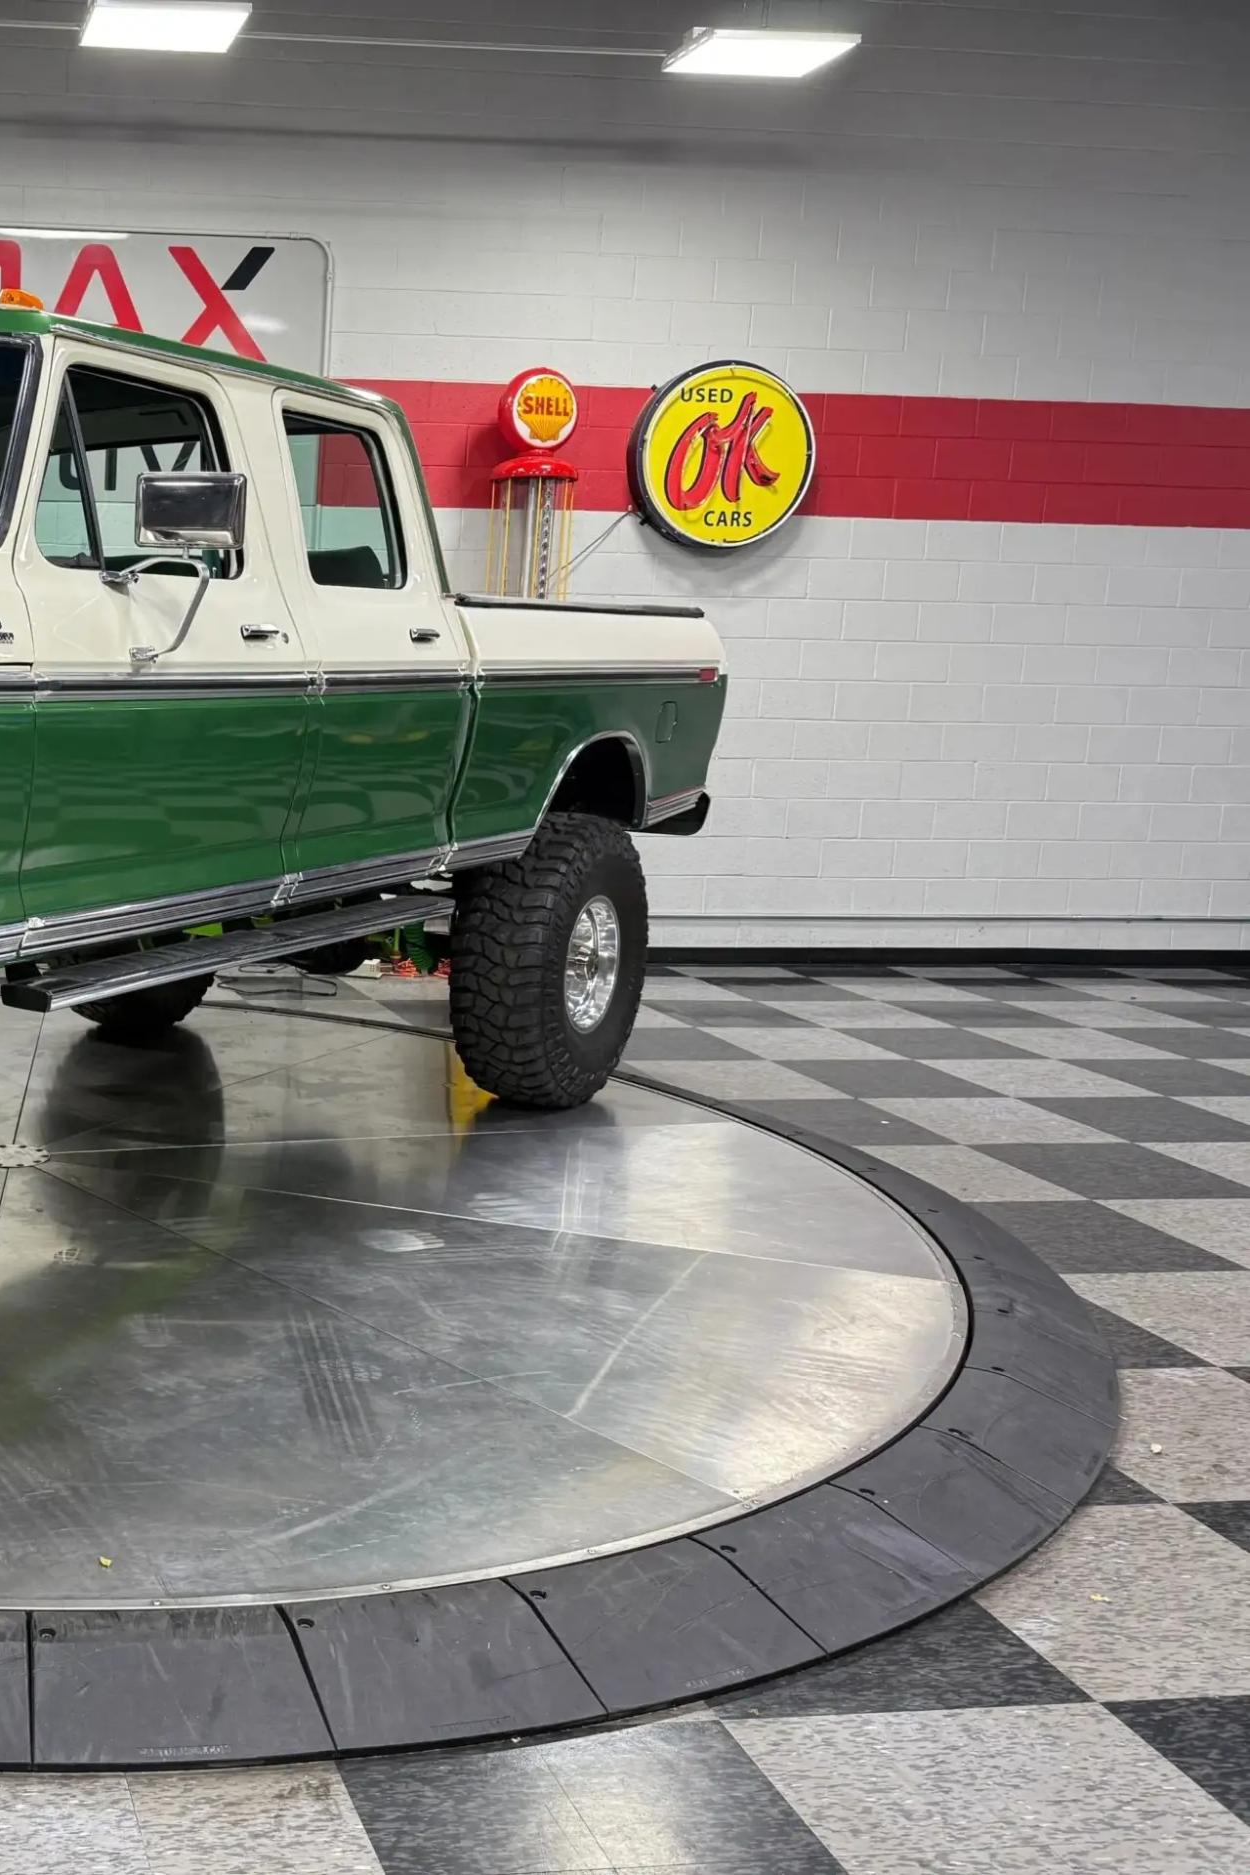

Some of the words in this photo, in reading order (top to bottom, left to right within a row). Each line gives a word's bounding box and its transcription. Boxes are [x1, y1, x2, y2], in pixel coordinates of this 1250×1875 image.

[681, 387, 733, 403] USED
[521, 395, 570, 417] SHELL
[664, 391, 781, 511] OK
[703, 510, 752, 527] CARS
